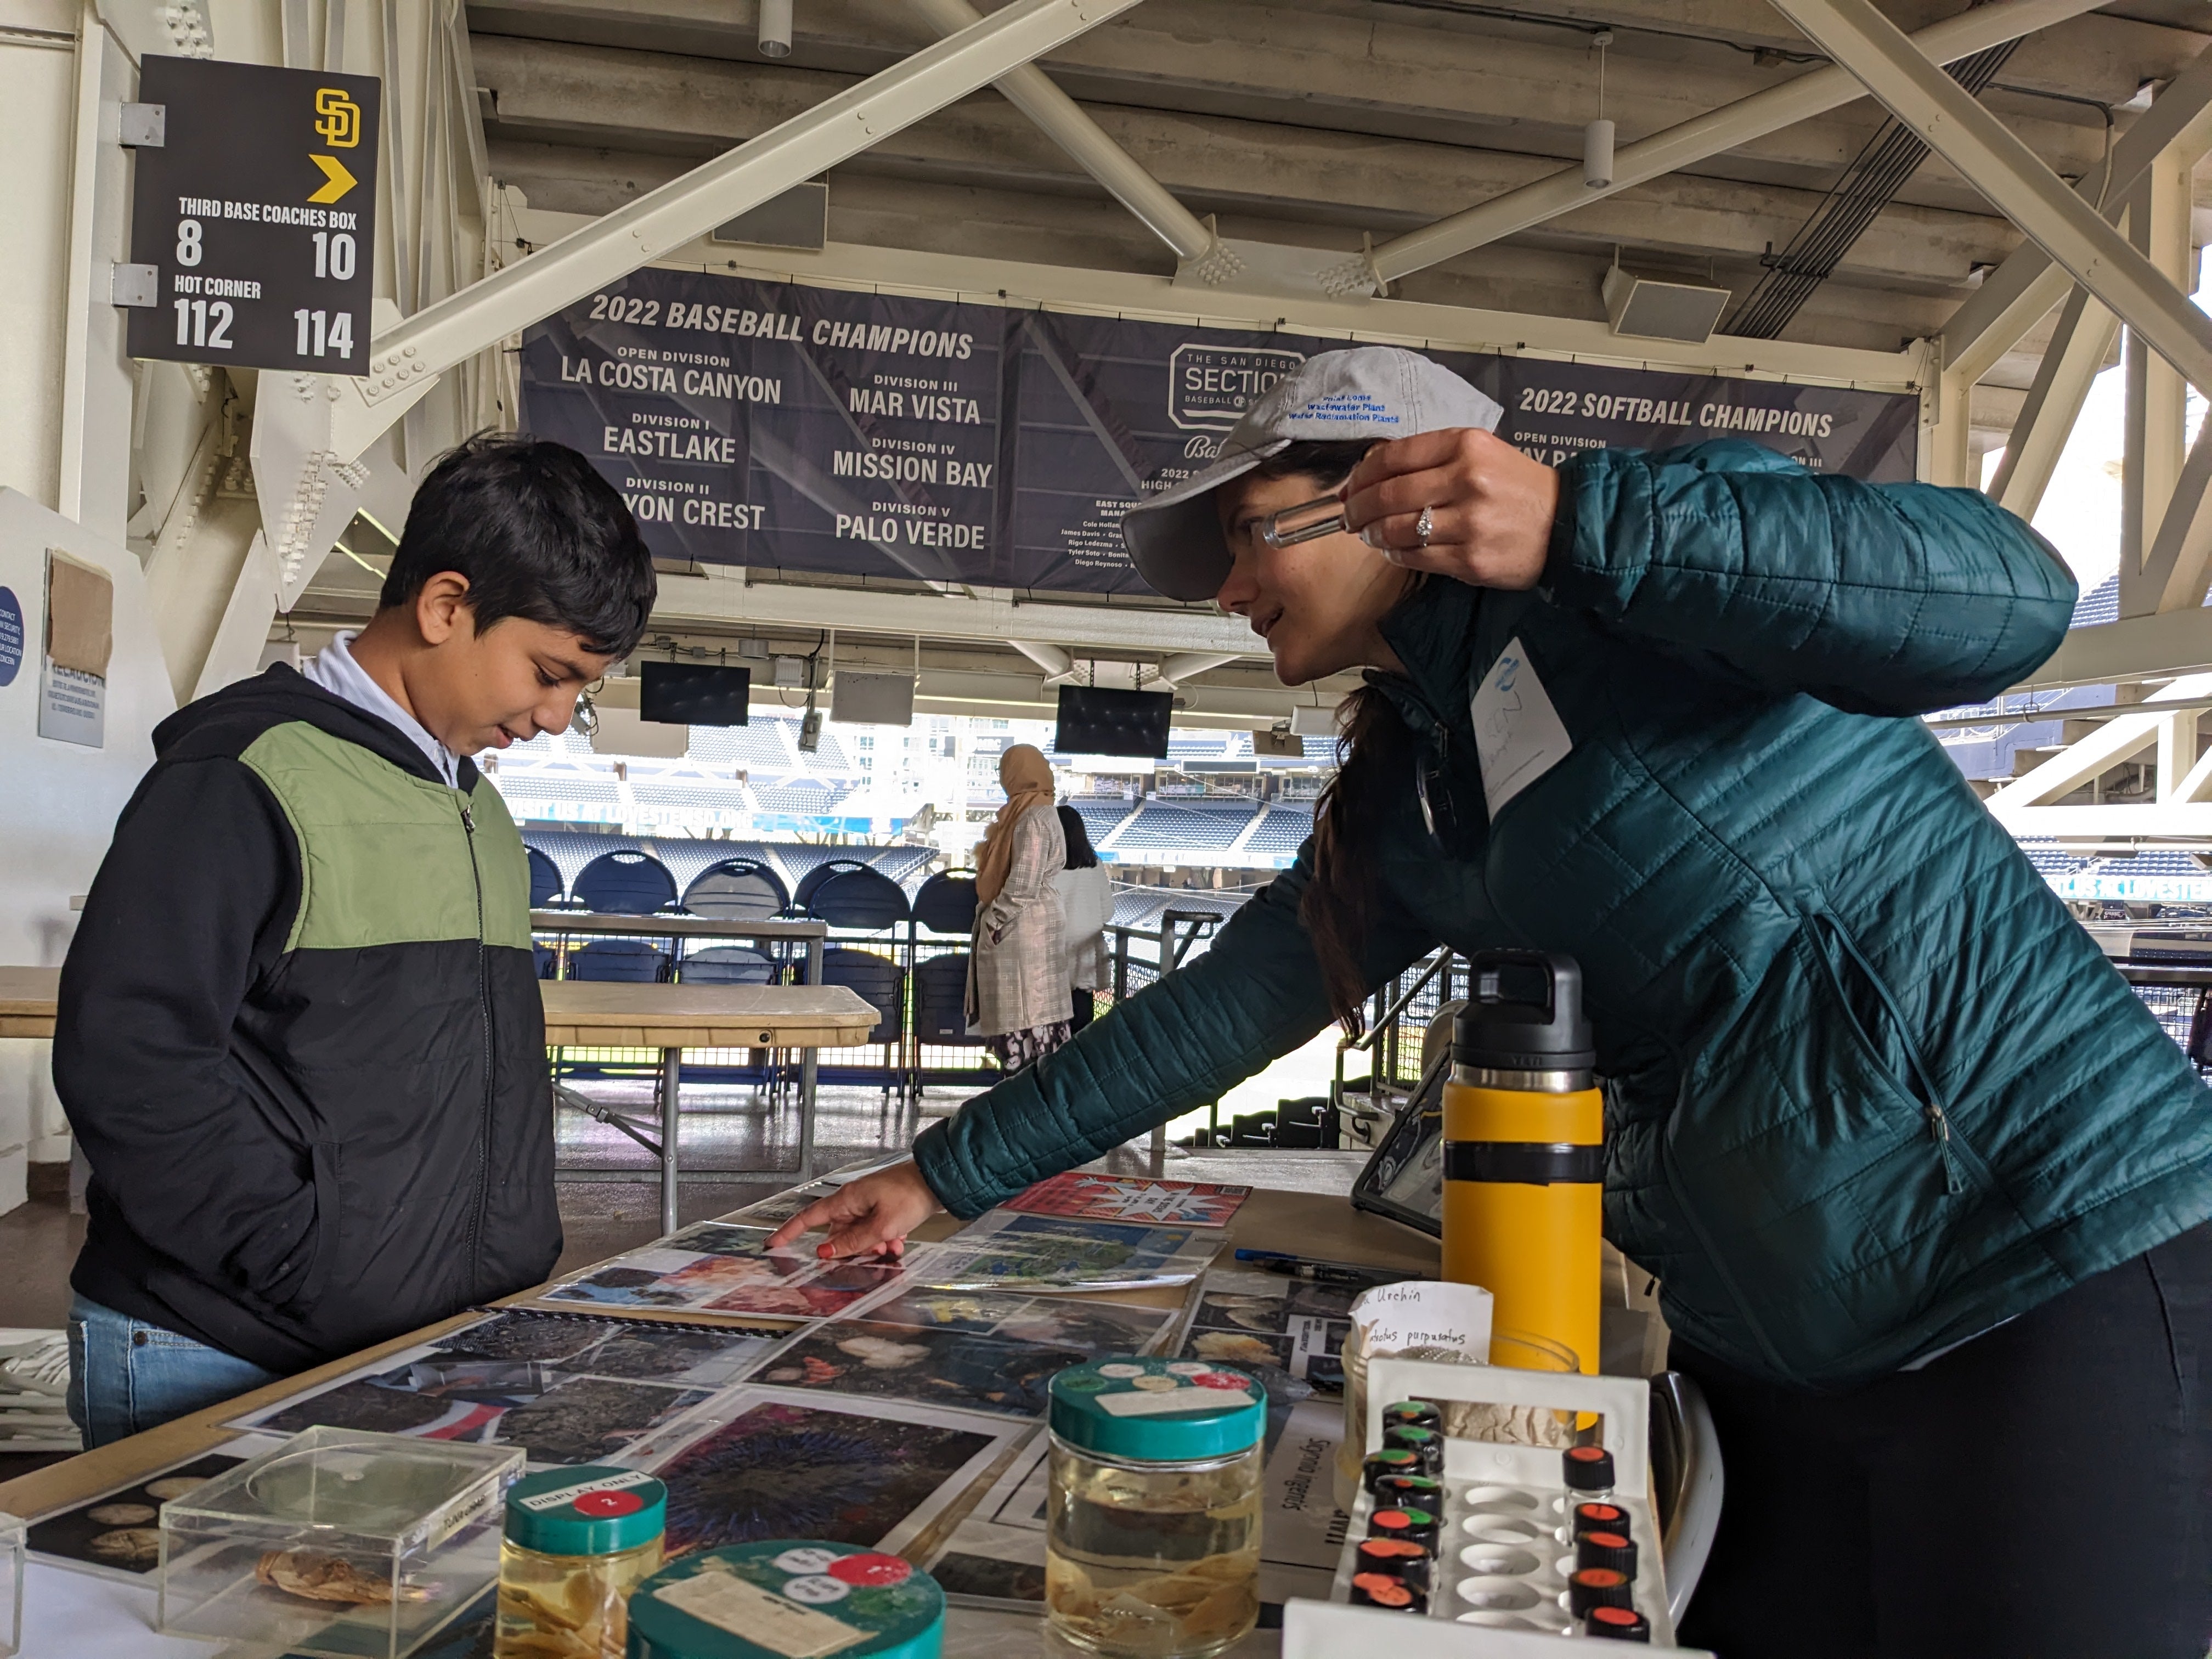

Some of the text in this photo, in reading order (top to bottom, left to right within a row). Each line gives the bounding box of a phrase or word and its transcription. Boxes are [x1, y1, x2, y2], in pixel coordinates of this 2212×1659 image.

[179, 197, 357, 230] THIRD BASE COACHES BOX
[176, 219, 202, 267] 8
[313, 232, 356, 280] 10
[174, 275, 261, 299] HOT CORNER
[174, 298, 234, 349] 112
[294, 308, 354, 359] 114
[590, 294, 974, 360] 2022 BASEBALL CHAMPIONS
[617, 346, 731, 367] OPEN DIVISION
[1187, 354, 1296, 369] THE SAN DIEGO
[561, 356, 781, 405] LA COSTA CANYON
[874, 374, 958, 392] DIVISION III
[1185, 367, 1285, 393] SECTIO
[850, 387, 981, 426] MAR VISTA
[1185, 395, 1231, 404] BASEBALL
[632, 412, 710, 430] DIVISION I
[1520, 388, 1833, 438] 2022 SOFTBALL CHAMPIONS
[603, 426, 736, 464] EASTLAKE
[872, 437, 956, 455] DIVISION IV
[1514, 432, 1606, 449] OPEN DIVISION
[833, 450, 993, 489] MISSION BAY
[1161, 469, 1189, 479] 2022
[626, 477, 710, 495] DIVISION II
[1141, 481, 1172, 490] HIGH
[623, 493, 765, 531] YON CREST
[872, 501, 951, 517] DIVISION V
[836, 514, 985, 550] PALO VERDE
[1068, 539, 1083, 548] Rigo
[1094, 560, 1122, 568] Reynoso
[511, 799, 753, 829] VISIT US AT LOVESTEMSD.ORG
[2074, 879, 2097, 898] US
[1377, 1288, 1420, 1302] Urchin
[529, 1474, 641, 1507] DISPLAY ONLY
